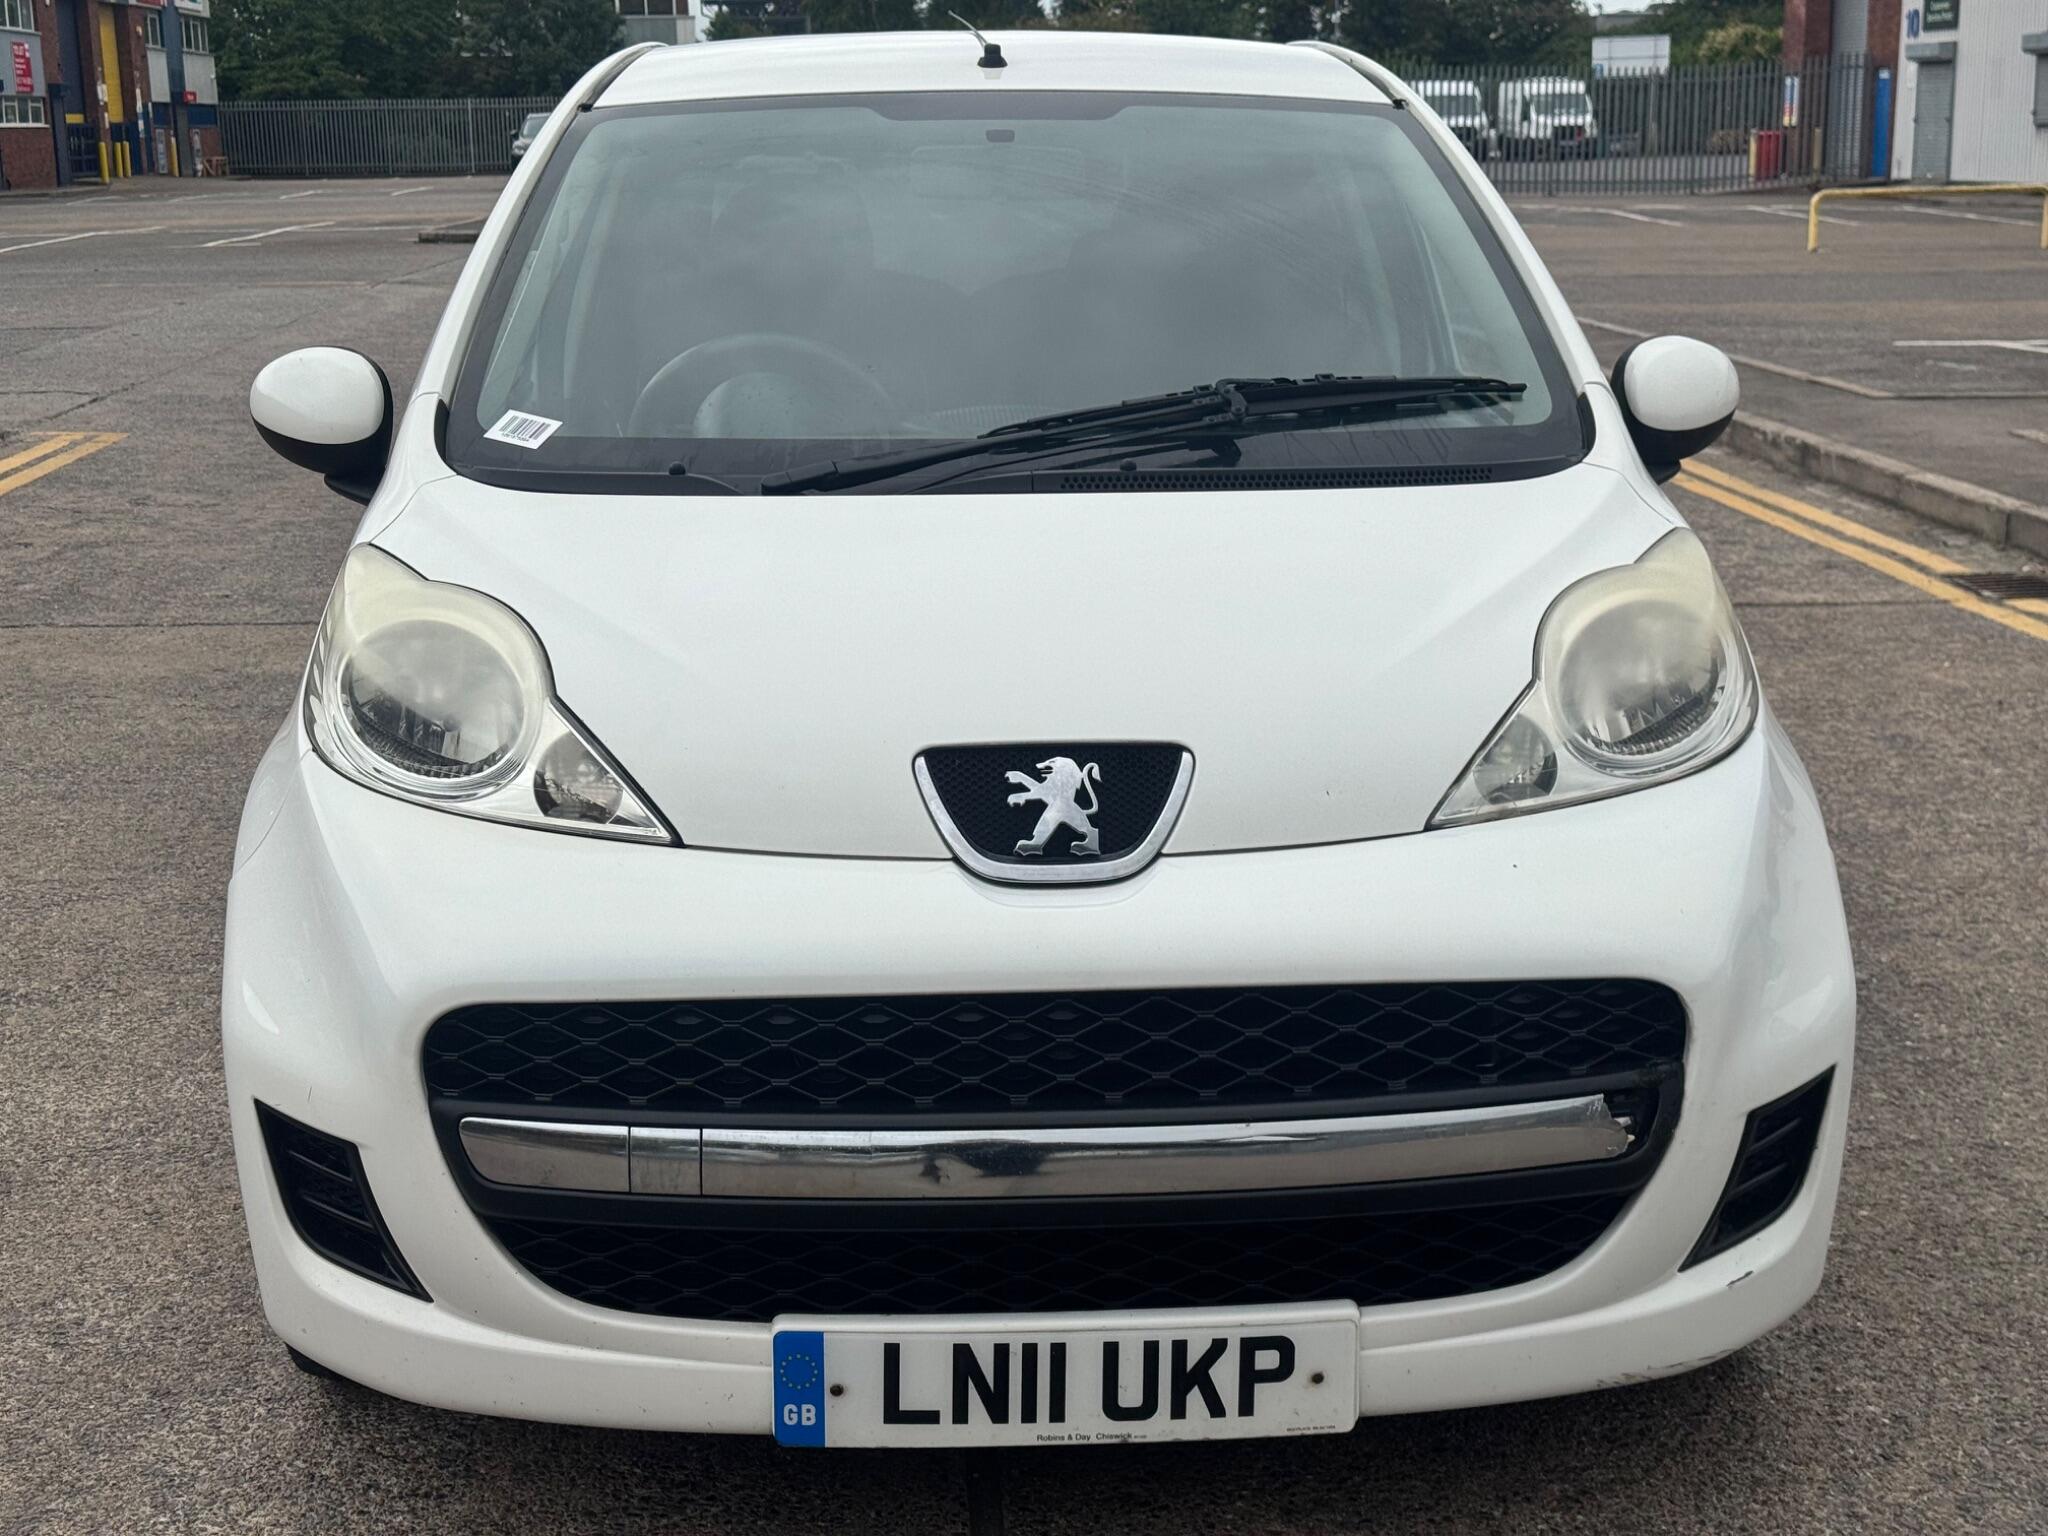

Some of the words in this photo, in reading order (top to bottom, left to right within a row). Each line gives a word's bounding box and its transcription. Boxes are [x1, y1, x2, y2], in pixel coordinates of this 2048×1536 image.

[883, 1342, 1067, 1425] LN11
[1102, 1334, 1296, 1422] UKP
[783, 1403, 816, 1426] GB
[1036, 1433, 1066, 1442] Robins
[1075, 1433, 1091, 1442] Day
[1095, 1431, 1133, 1441] Chiswick
